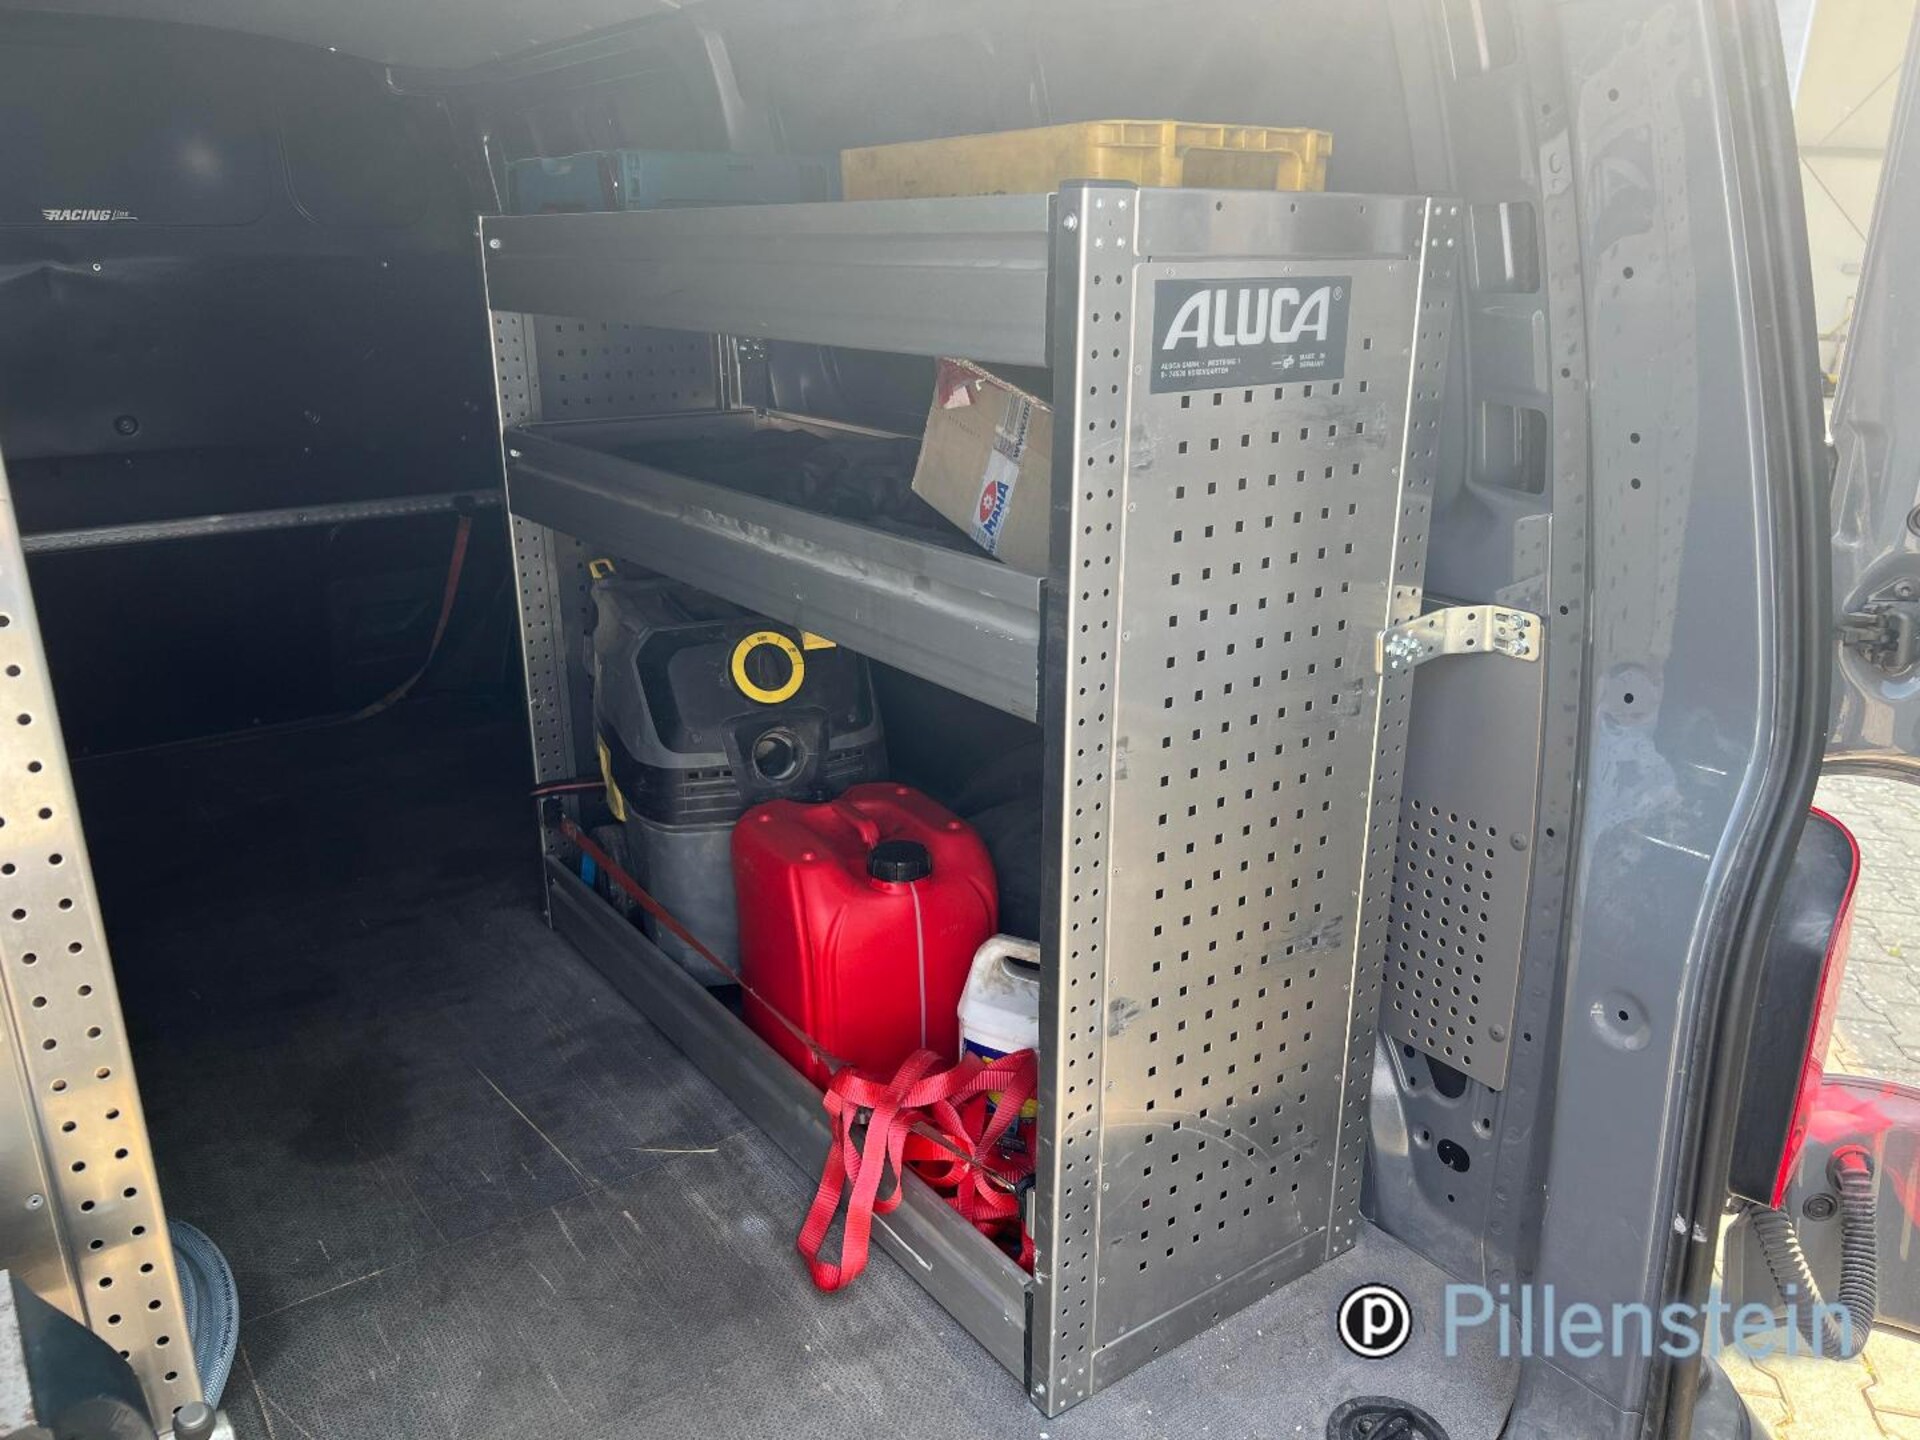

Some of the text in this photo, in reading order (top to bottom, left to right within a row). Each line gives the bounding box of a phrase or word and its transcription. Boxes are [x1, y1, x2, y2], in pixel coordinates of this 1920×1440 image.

[42, 209, 112, 221] RACING
[1162, 286, 1331, 350] ALUCA
[983, 481, 1009, 536] MAHA
